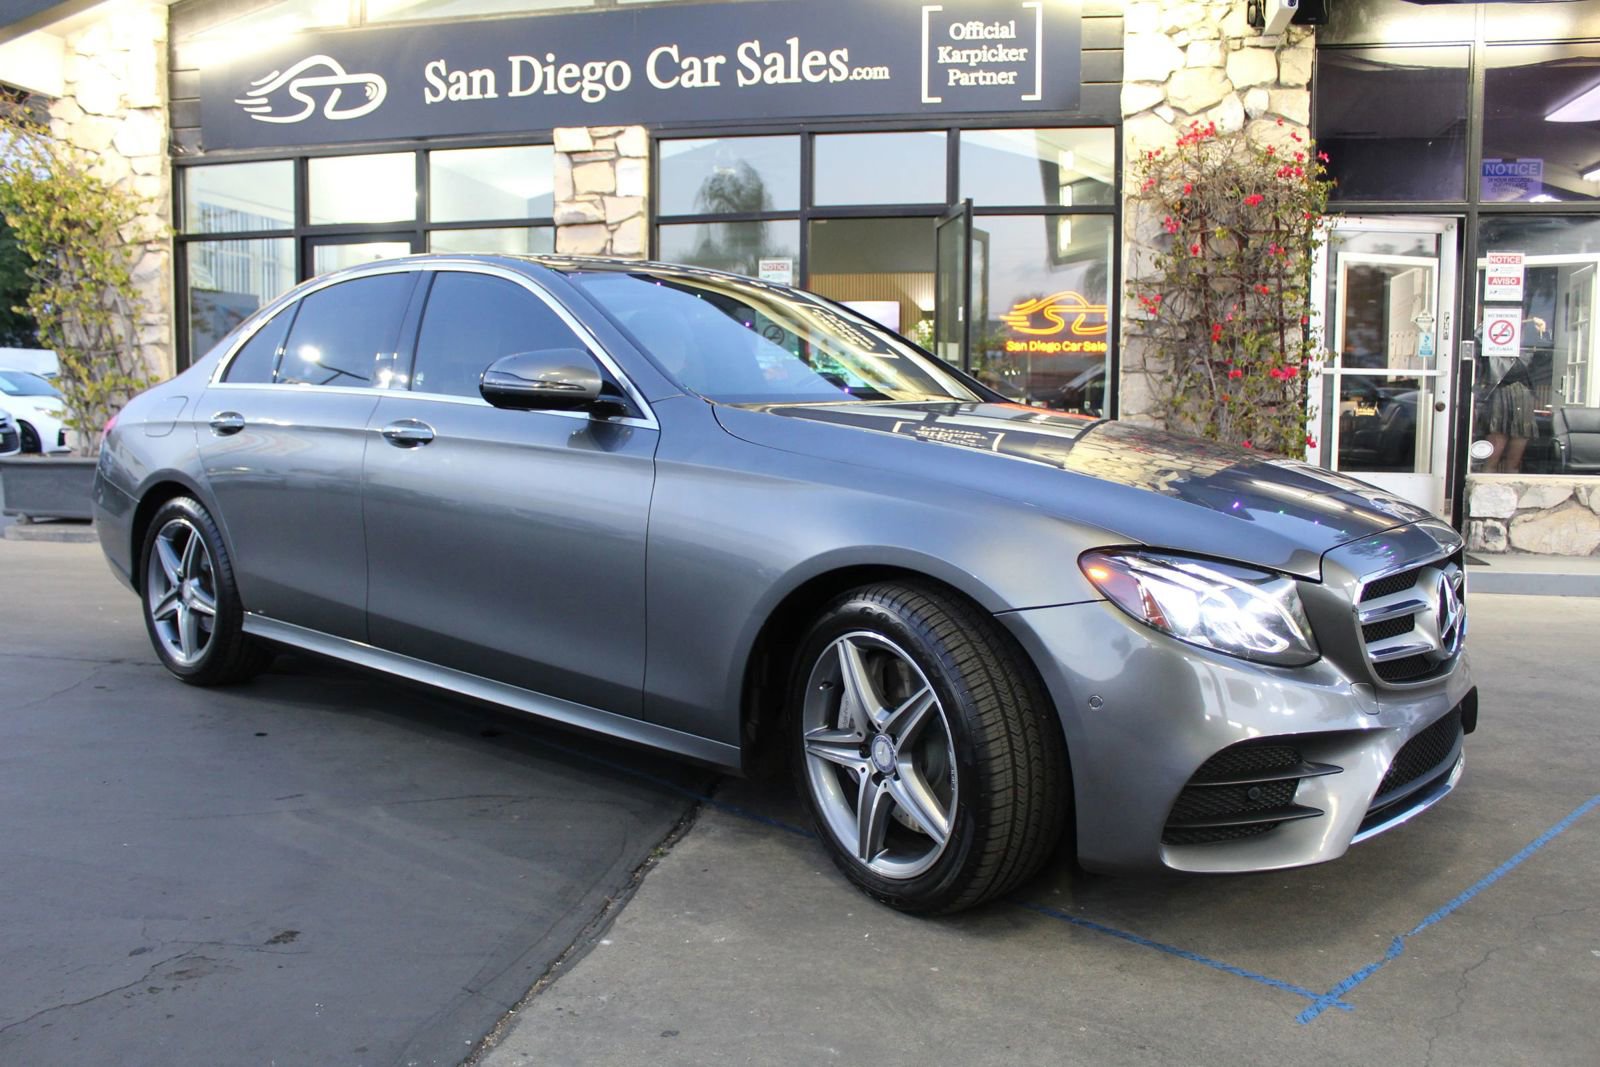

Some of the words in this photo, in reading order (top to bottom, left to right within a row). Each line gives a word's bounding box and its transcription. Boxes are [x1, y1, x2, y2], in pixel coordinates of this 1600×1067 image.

[948, 20, 1016, 40] Official
[937, 44, 1028, 66] Karpicker
[424, 59, 498, 105] San
[508, 53, 631, 104] Diego
[646, 44, 726, 90] Car
[736, 36, 890, 88] Sales.com
[947, 68, 1017, 86] Partner
[1485, 163, 1538, 175] NOTICE
[762, 263, 789, 271] NOTICE
[1489, 256, 1521, 264] NOTICE
[1492, 277, 1517, 285] AVISO
[1006, 340, 1028, 352] San
[1029, 339, 1061, 353] Diego
[1062, 340, 1082, 352] Car
[1083, 340, 1108, 352] Sale
